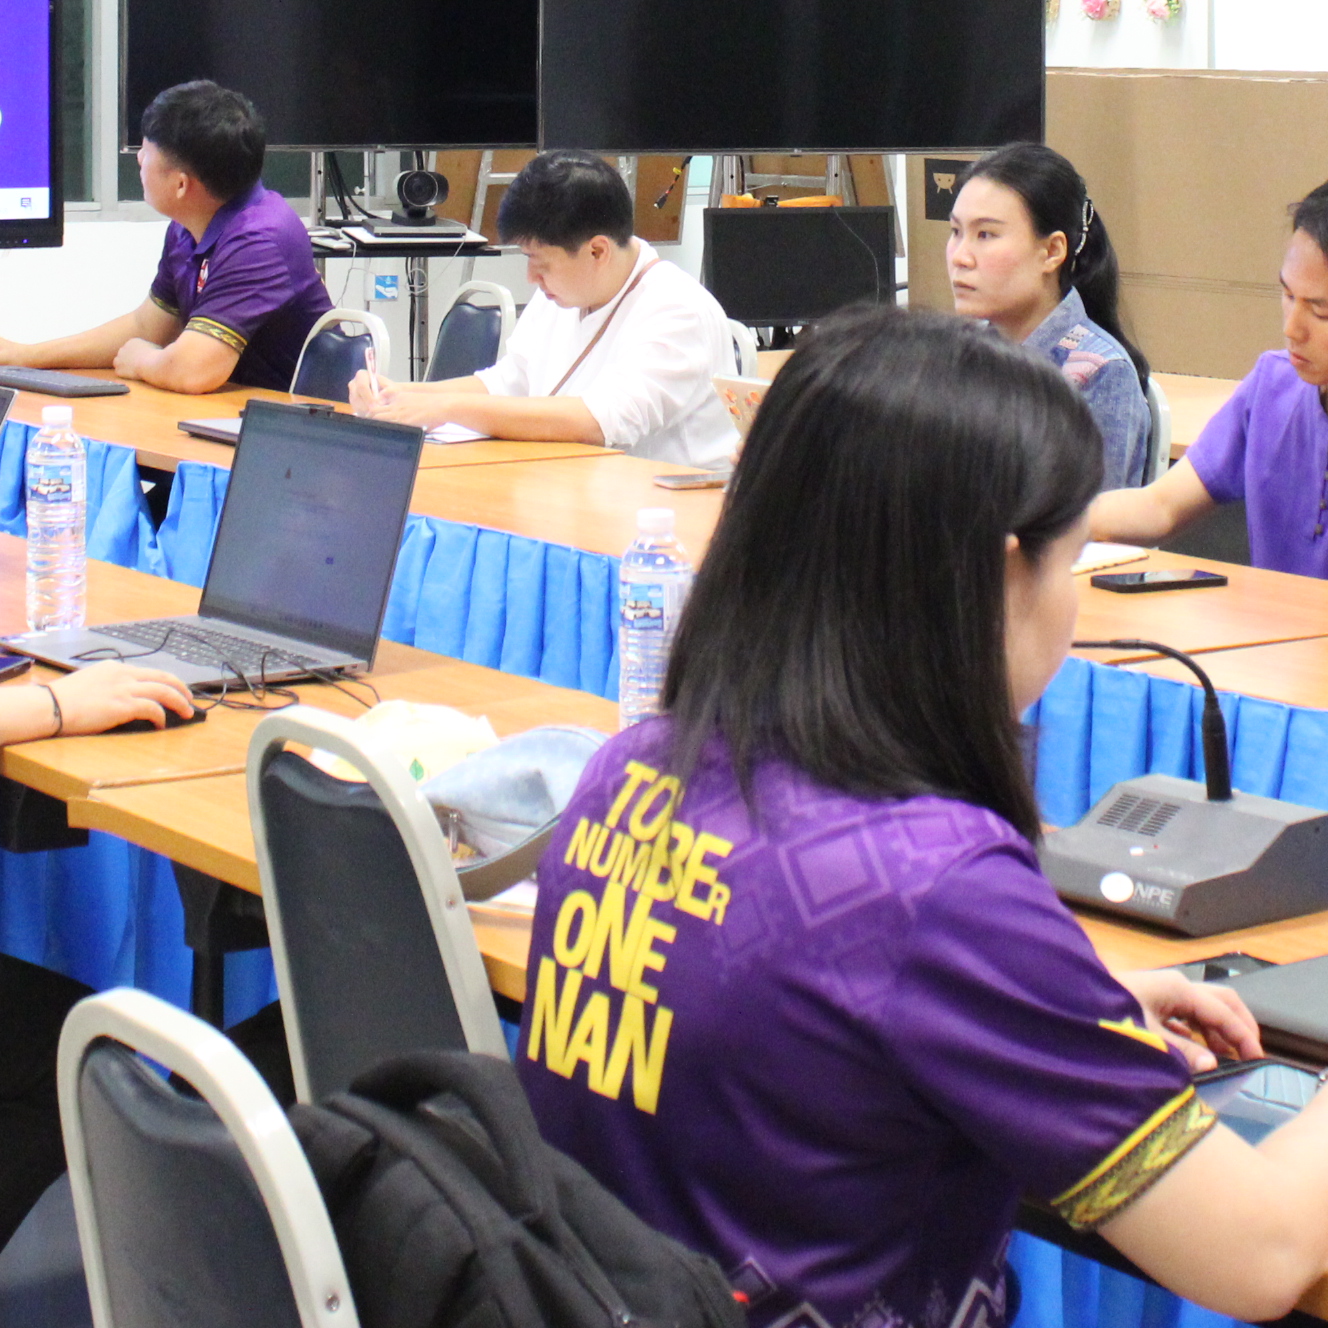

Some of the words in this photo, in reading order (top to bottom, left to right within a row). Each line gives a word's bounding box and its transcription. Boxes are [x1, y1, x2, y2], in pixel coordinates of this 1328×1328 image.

[605, 760, 685, 842] TO
[553, 881, 677, 1005] ONE
[1134, 882, 1175, 905] NPE
[527, 956, 674, 1115] NAN
